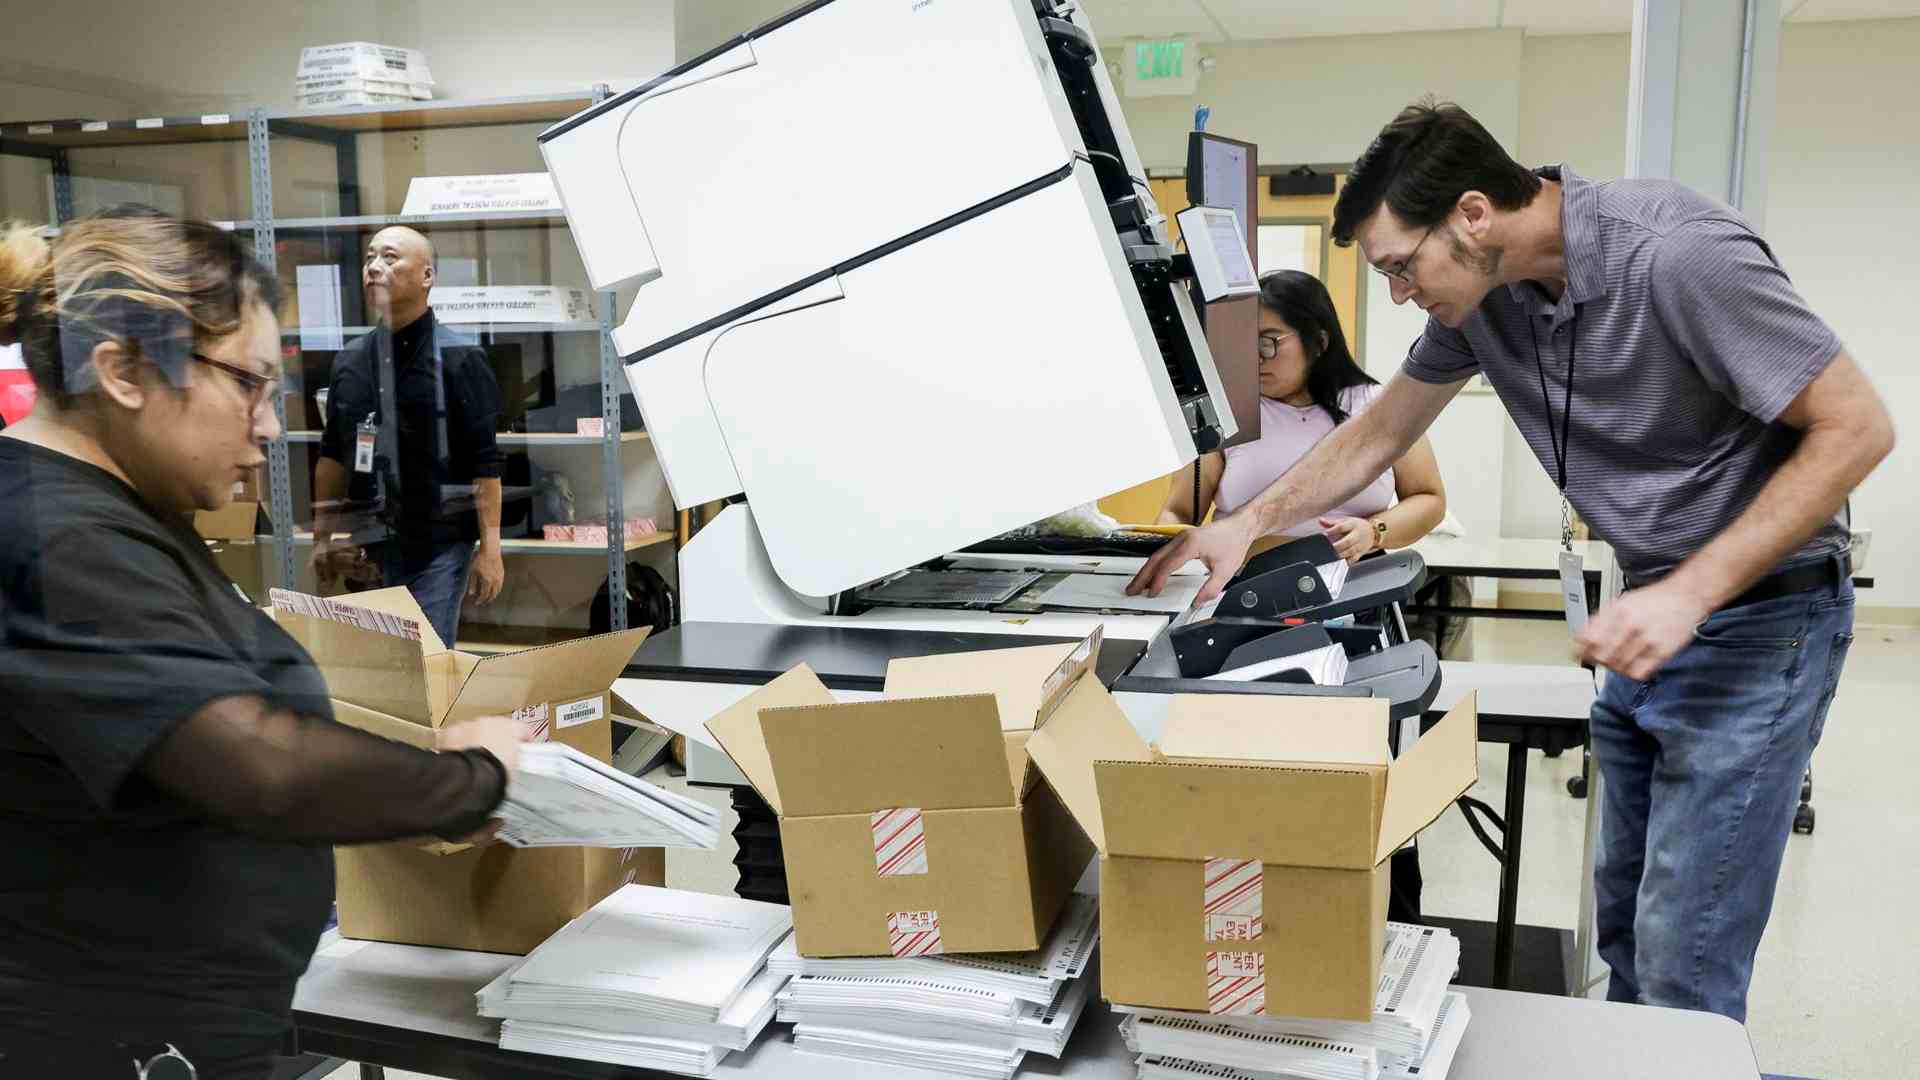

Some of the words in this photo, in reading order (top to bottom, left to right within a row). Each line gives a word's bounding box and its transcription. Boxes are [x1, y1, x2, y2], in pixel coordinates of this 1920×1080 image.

[1136, 42, 1184, 79] EXIT
[446, 302, 474, 310] POSTAL
[506, 301, 536, 309] UNITED
[1244, 952, 1254, 970] ER
